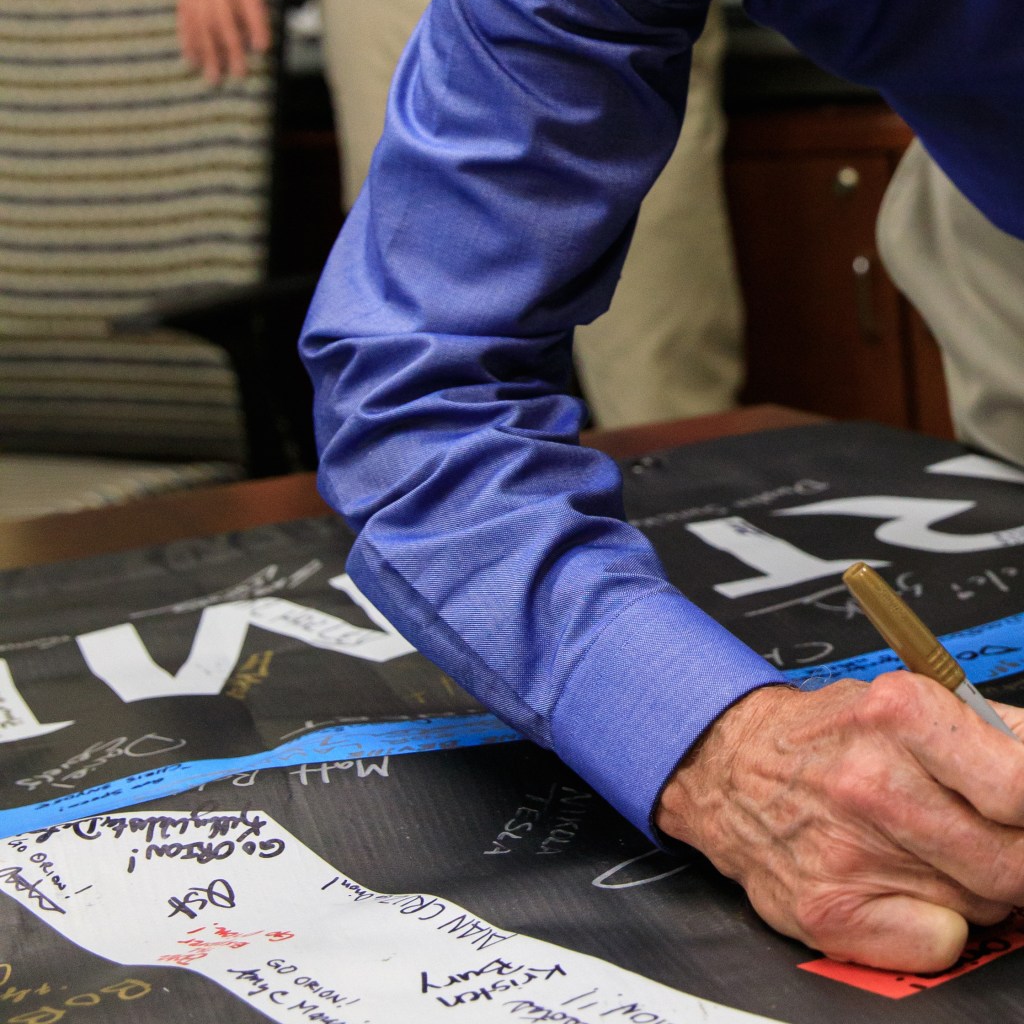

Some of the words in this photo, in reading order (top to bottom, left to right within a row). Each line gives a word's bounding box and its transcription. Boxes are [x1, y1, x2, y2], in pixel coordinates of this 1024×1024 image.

[289, 755, 391, 786] Matt
[483, 782, 557, 855] TESLA
[536, 786, 593, 855] NIKOLA
[437, 913, 518, 951] ALAN
[266, 958, 298, 974] GO
[294, 976, 361, 1009] ORION!
